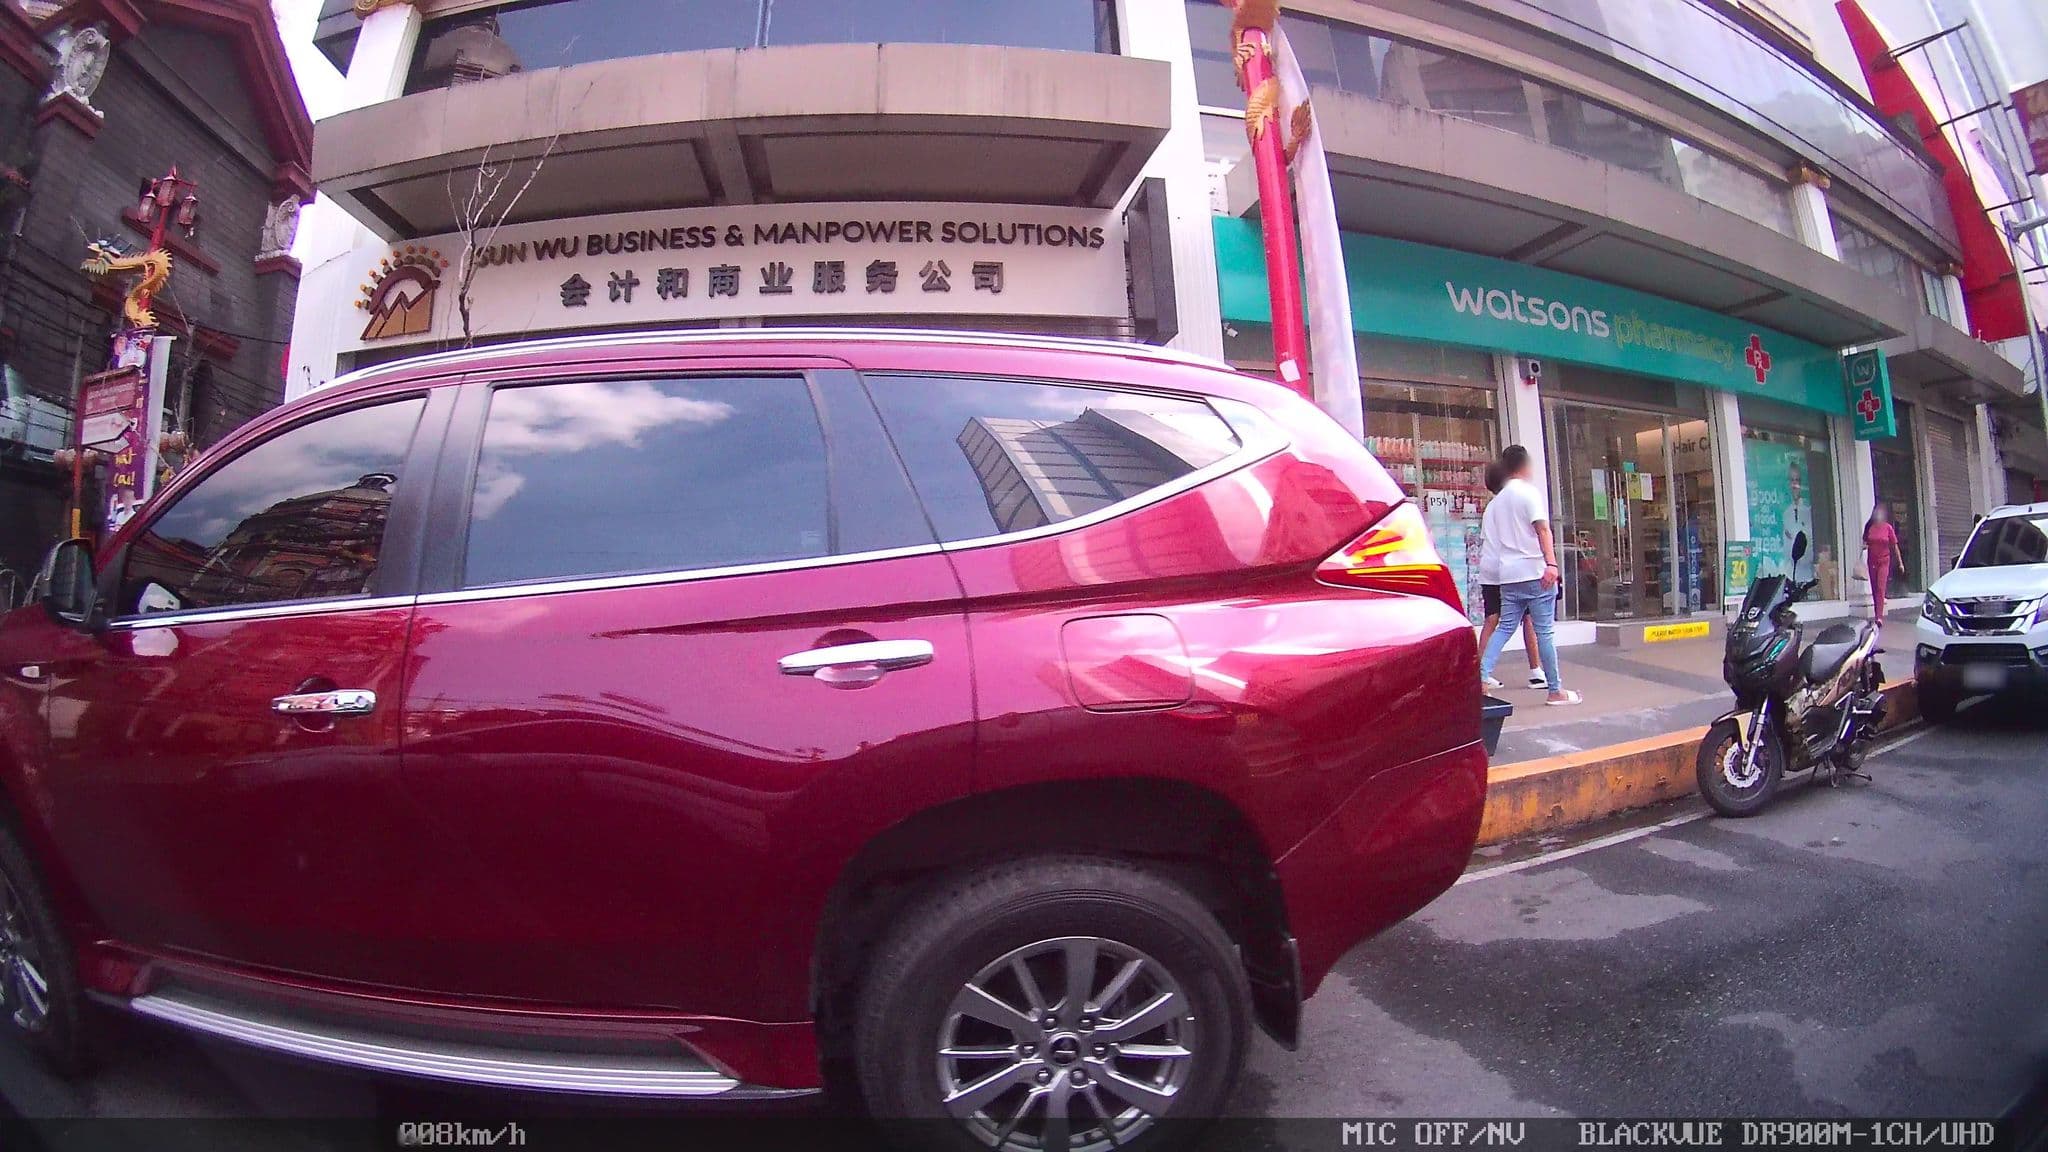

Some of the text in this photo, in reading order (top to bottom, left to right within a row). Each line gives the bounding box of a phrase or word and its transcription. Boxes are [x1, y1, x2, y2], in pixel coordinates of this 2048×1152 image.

[475, 220, 1105, 268] SUN WU BUSINESS & MANPOWER SOLUTIONS
[560, 259, 1004, 307] 会计和商业服务公司
[1445, 281, 1610, 338] watsons
[1672, 438, 1696, 456] Hair
[1430, 497, 1448, 507] P59
